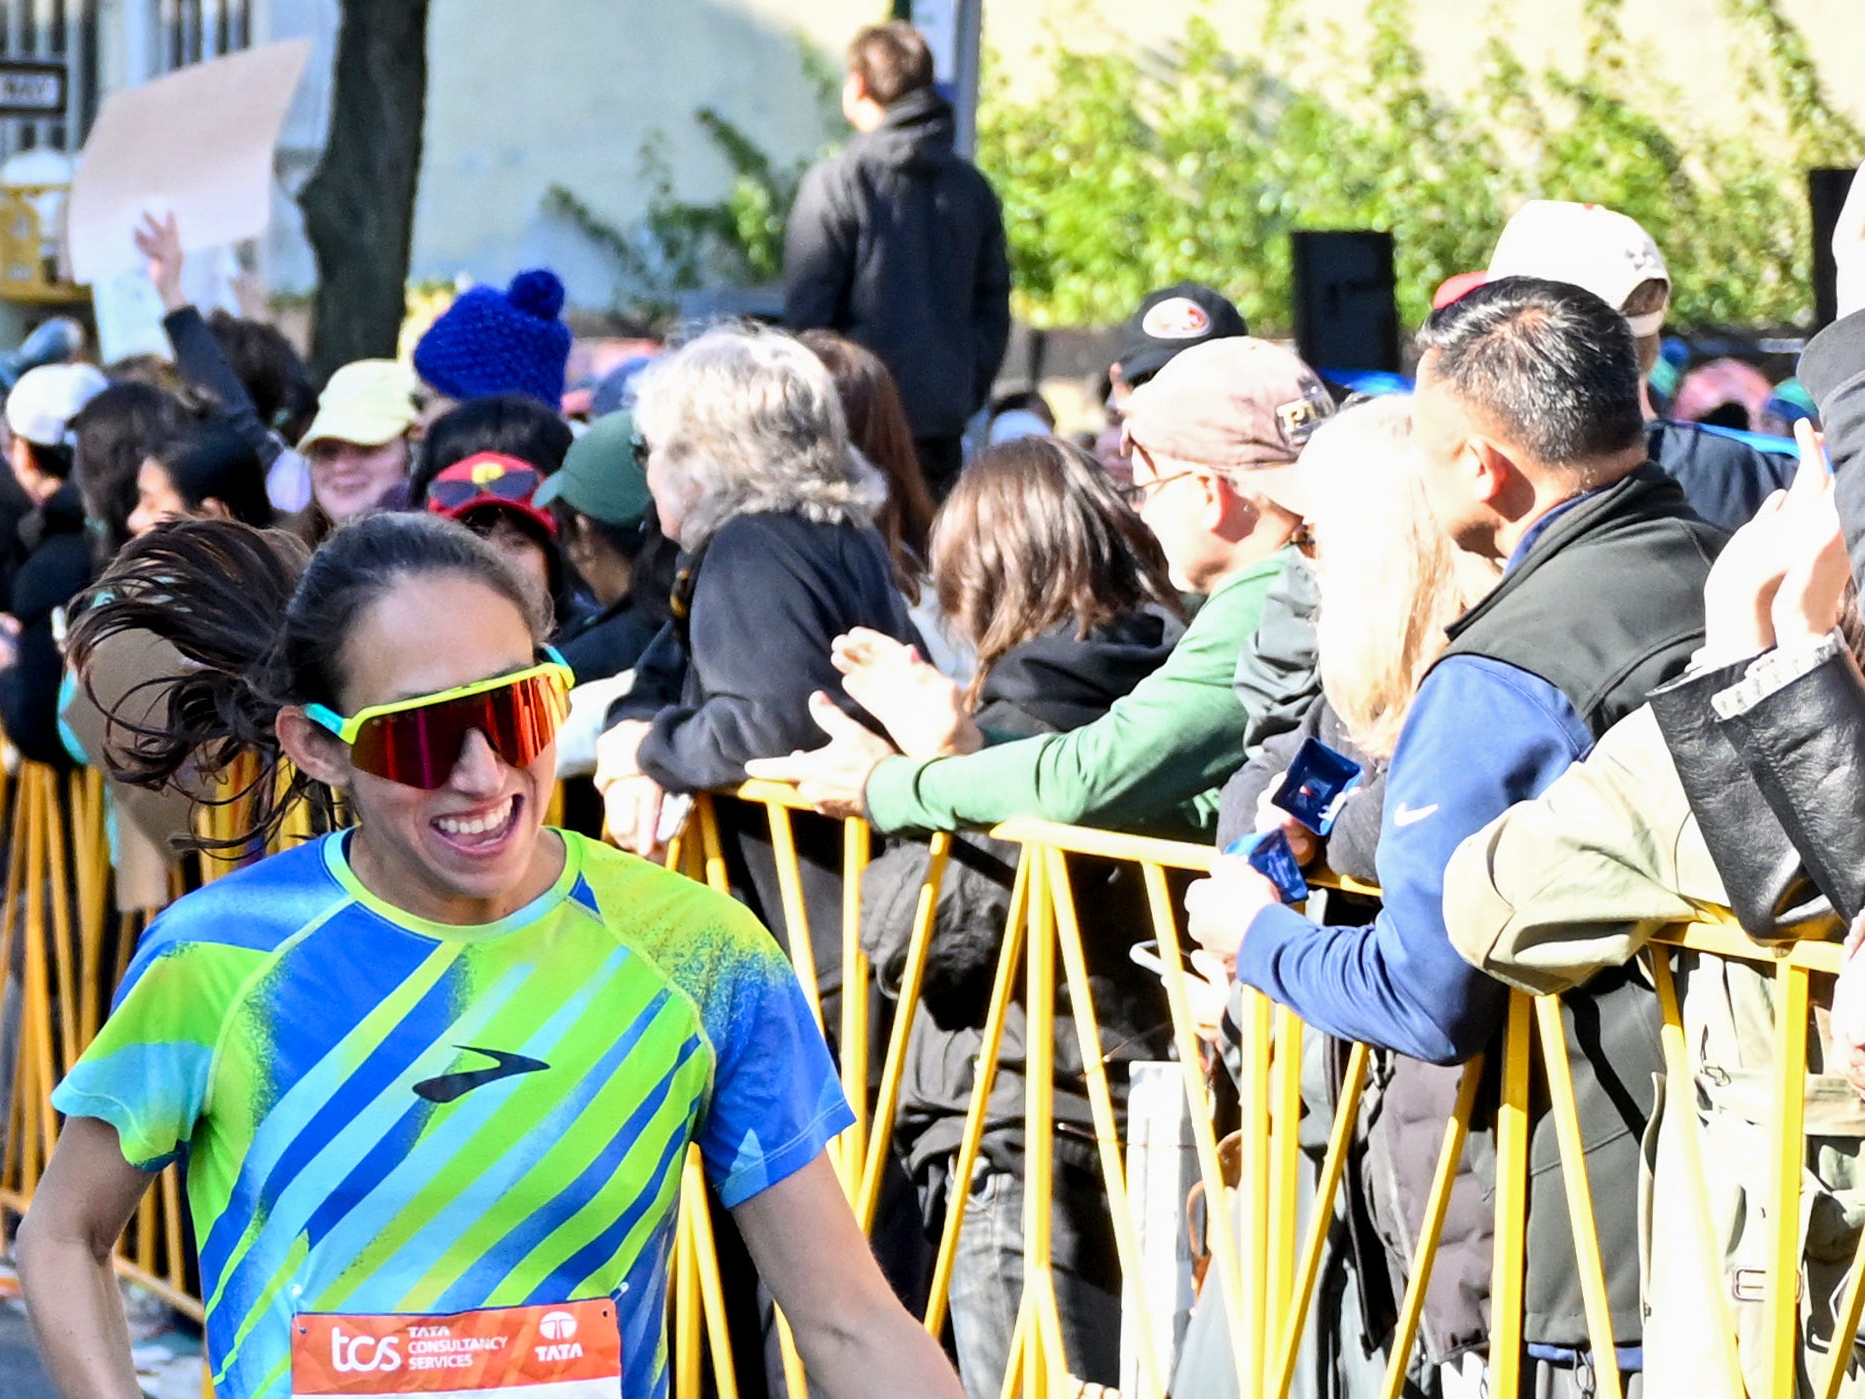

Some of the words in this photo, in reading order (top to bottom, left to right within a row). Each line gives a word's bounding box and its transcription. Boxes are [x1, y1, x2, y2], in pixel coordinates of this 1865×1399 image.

[406, 1326, 450, 1338] TATA
[330, 1326, 402, 1373] tcs
[407, 1336, 509, 1355] CONSULTANCY
[533, 1342, 585, 1362] TATA
[407, 1354, 474, 1371] SERVICES
